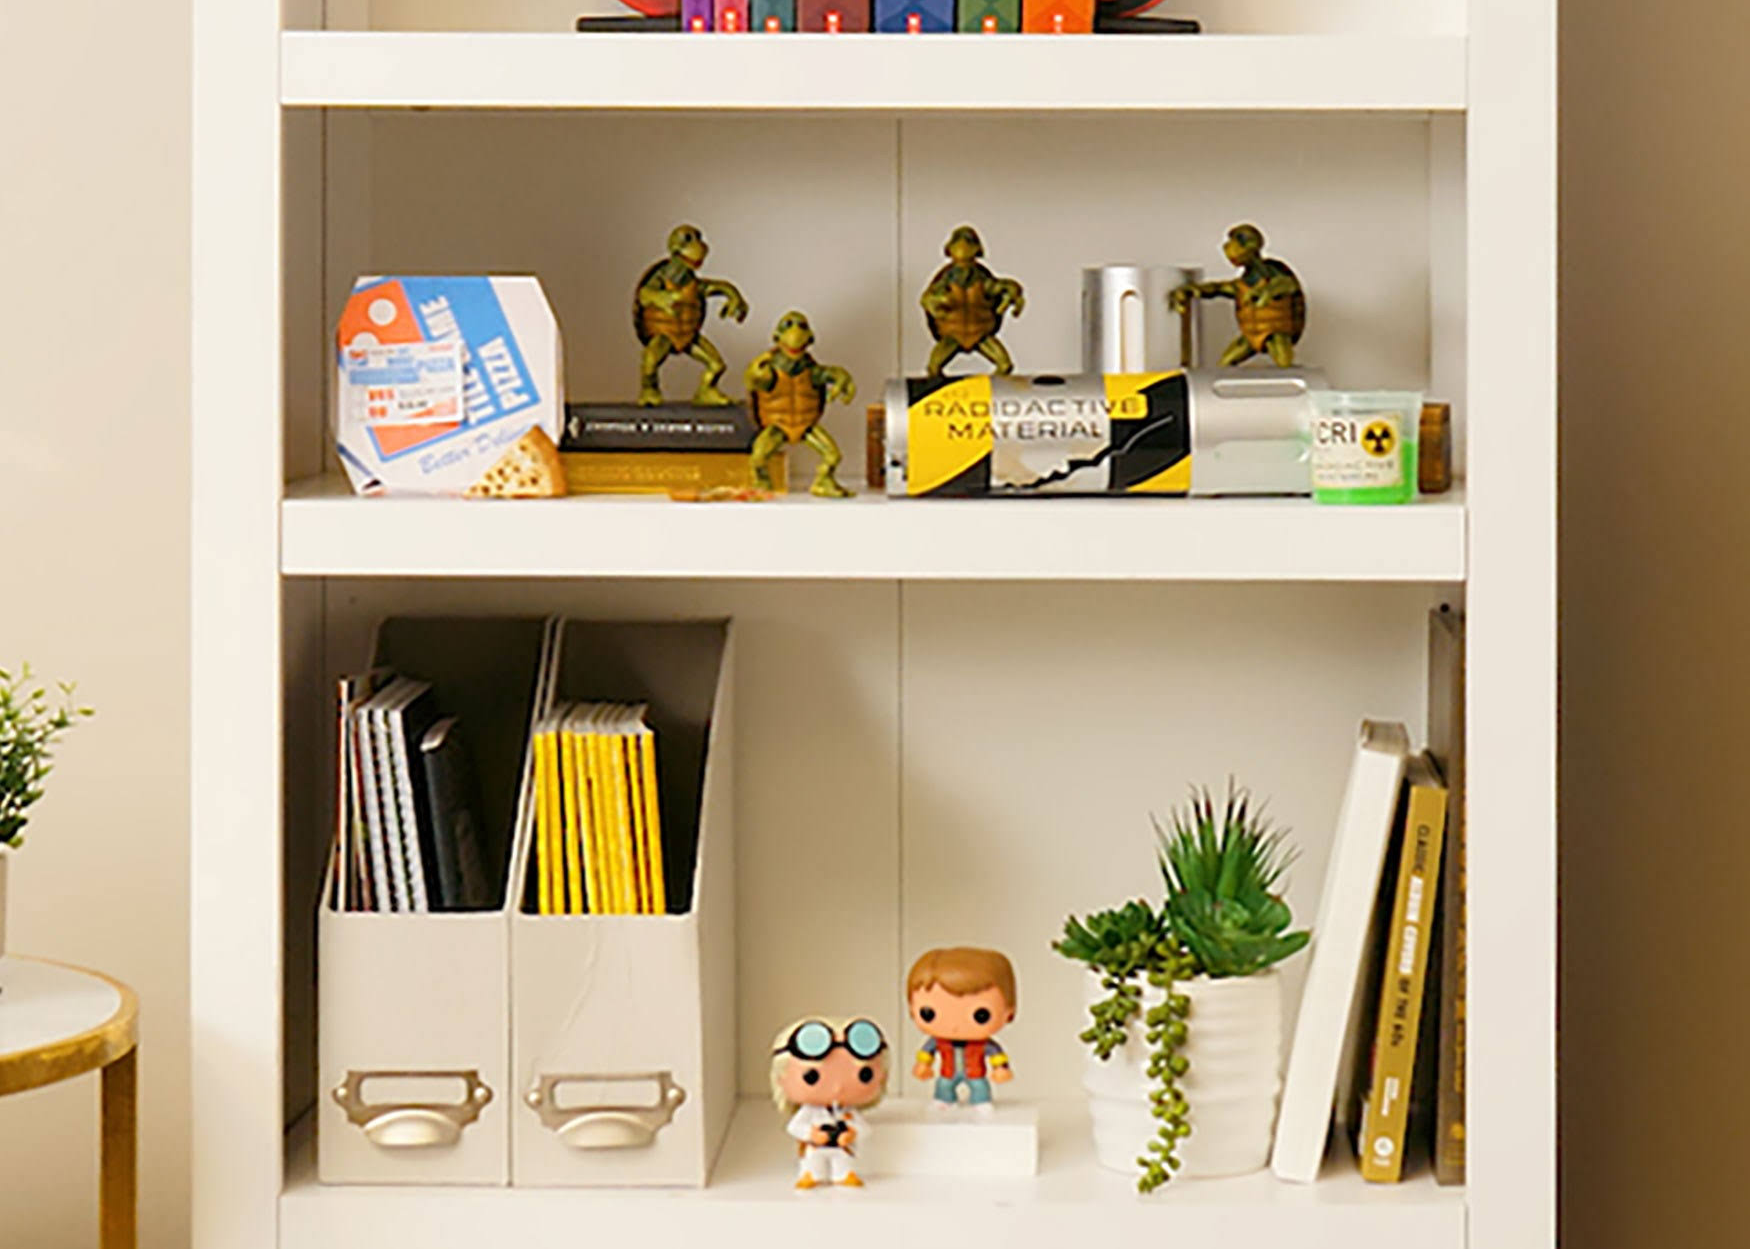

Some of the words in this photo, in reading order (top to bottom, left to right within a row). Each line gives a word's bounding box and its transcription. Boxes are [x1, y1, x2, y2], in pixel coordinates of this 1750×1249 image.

[924, 397, 1139, 418] RADIOACTIVE
[947, 420, 1104, 440] MATERIAL
[1317, 420, 1357, 444] CRI
